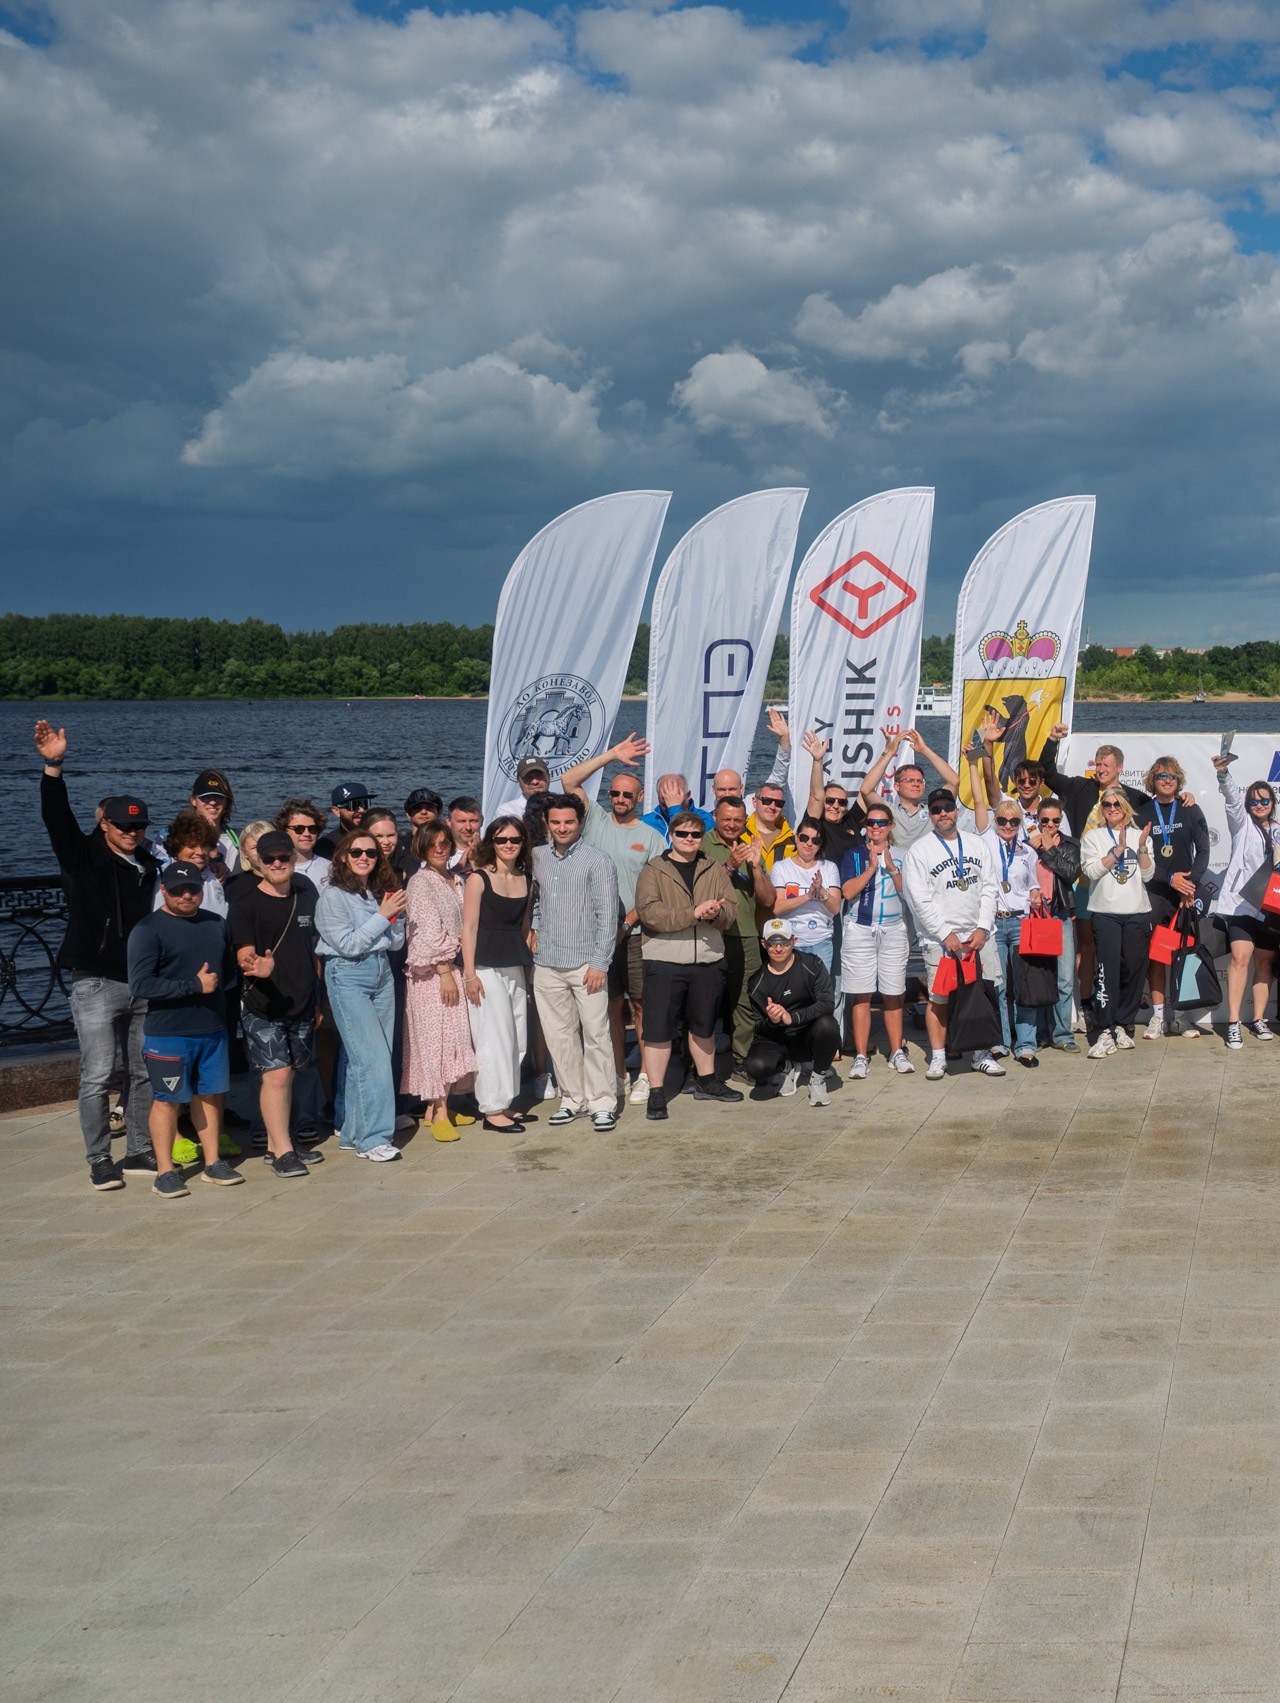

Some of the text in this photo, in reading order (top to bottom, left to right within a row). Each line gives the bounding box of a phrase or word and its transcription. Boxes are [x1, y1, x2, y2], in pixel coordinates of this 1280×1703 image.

[516, 678, 597, 709] АО КОНЕЗАВОД
[841, 656, 877, 798] USHIK
[881, 704, 902, 798] TCES
[930, 856, 983, 878] NORTH SAIL
